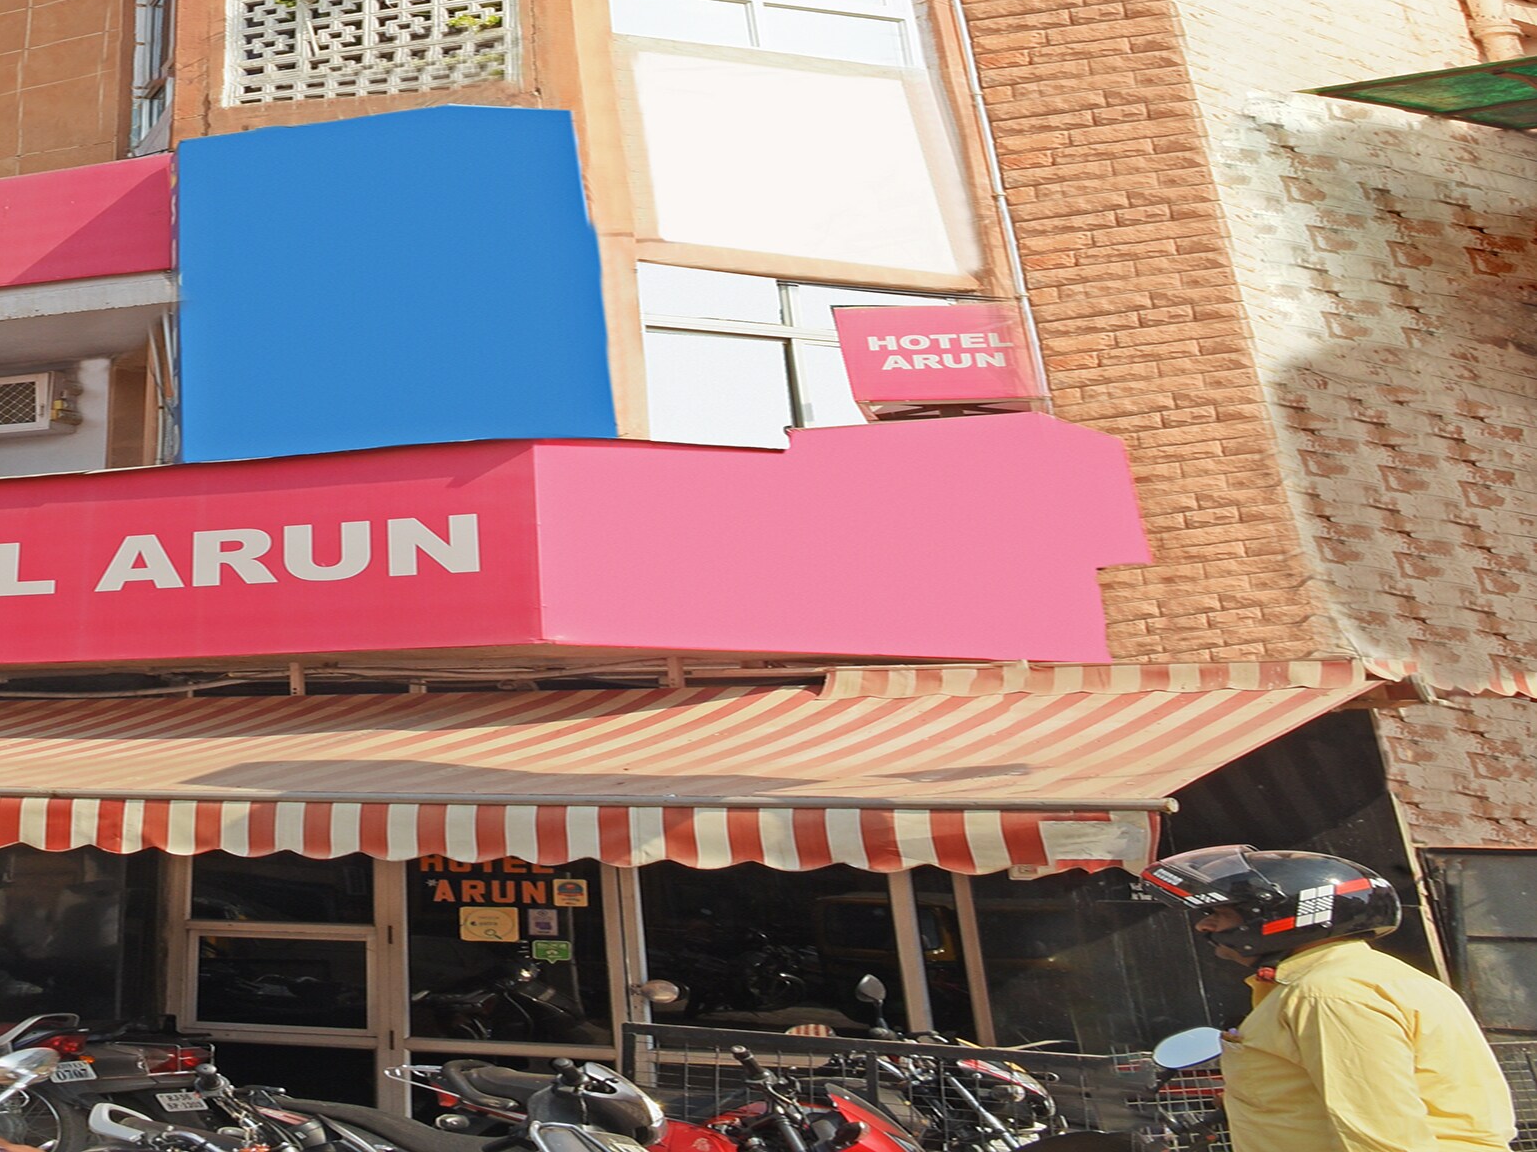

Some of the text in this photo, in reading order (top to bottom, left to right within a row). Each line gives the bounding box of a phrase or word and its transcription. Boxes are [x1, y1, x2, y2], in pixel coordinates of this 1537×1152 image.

[867, 332, 1013, 351] HOTEL
[881, 352, 1006, 371] ARUN
[94, 513, 481, 592] ARUN
[433, 879, 547, 904] ARUN
